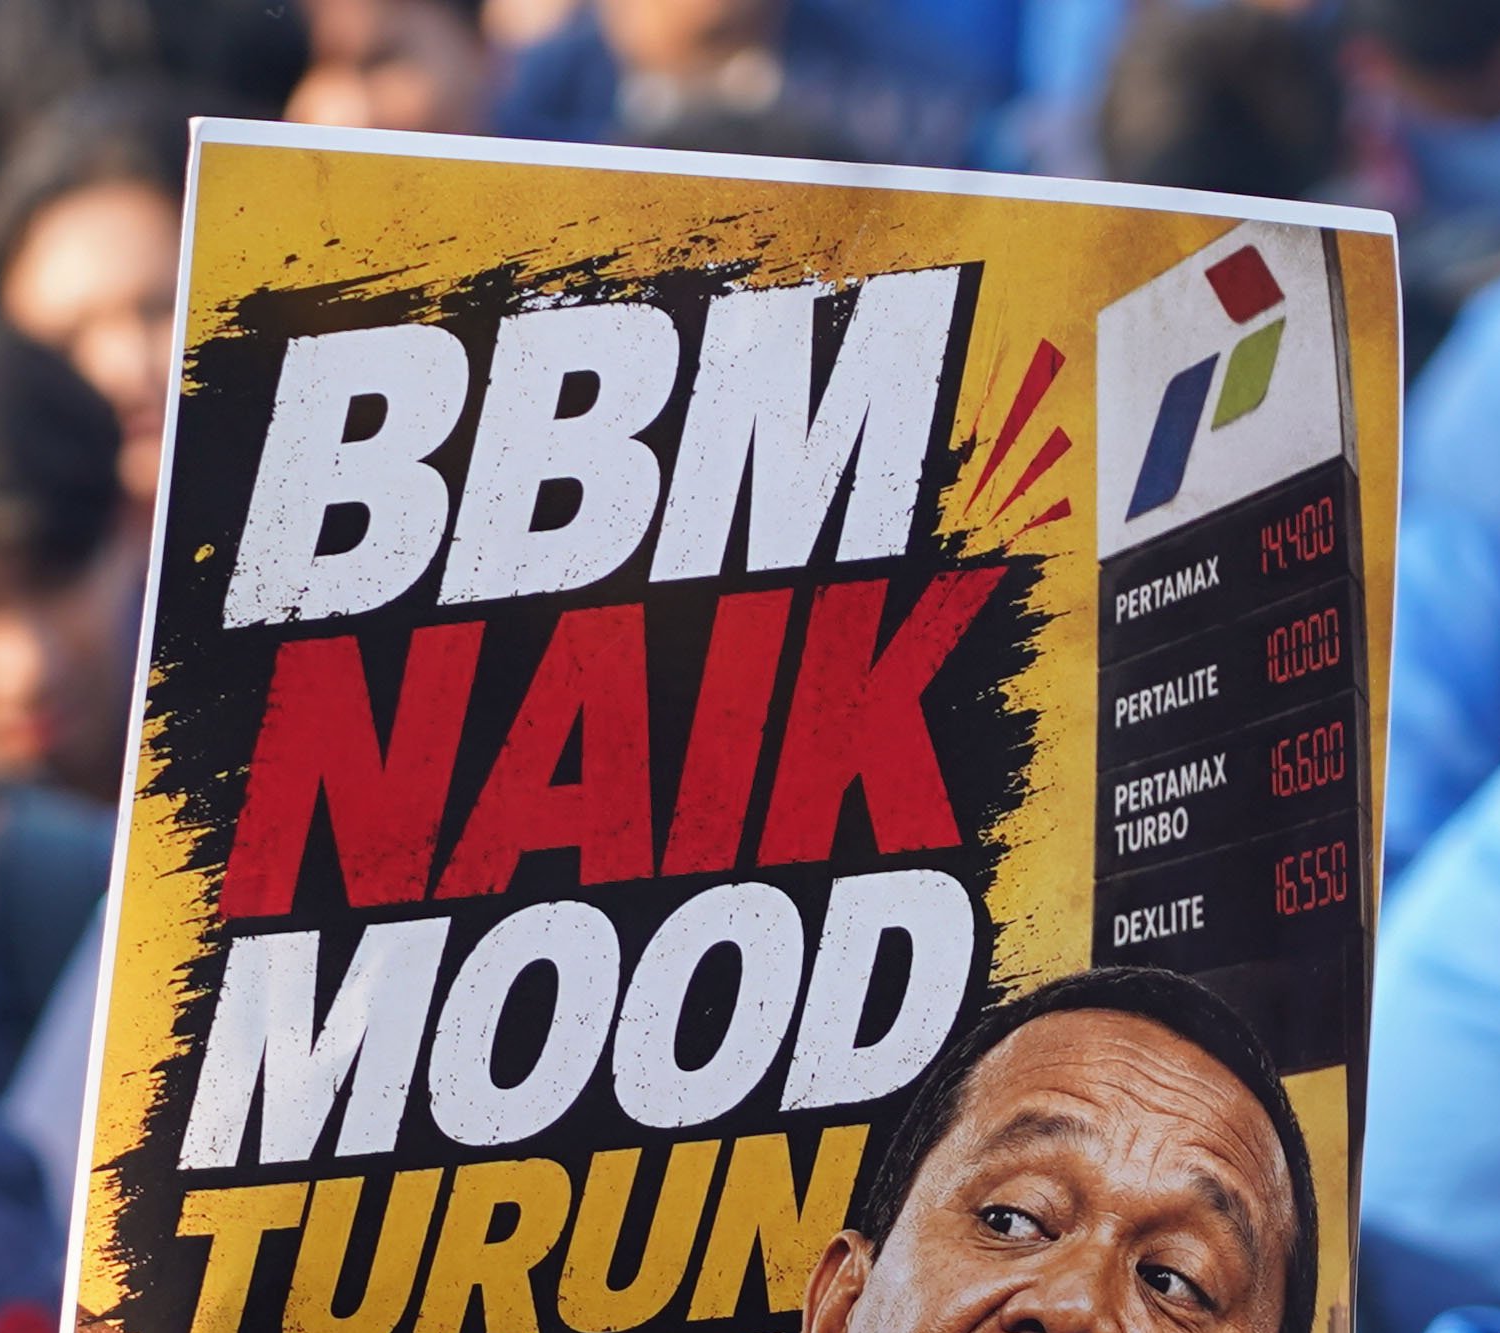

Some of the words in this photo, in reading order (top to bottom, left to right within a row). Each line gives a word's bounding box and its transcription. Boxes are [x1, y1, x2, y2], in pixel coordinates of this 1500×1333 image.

[223, 266, 961, 629] BBM
[1115, 555, 1220, 624] PERTAMAX
[1260, 496, 1335, 574] 14.400
[1115, 664, 1219, 728] PERTALITE
[1266, 607, 1341, 684] 10.000
[219, 566, 1008, 919] NAIK
[1114, 752, 1228, 817] PERTAMAX
[1271, 721, 1345, 797] 16.600
[1114, 806, 1189, 856] TURBO
[1113, 895, 1205, 947] DEXLITE
[1275, 841, 1347, 915] 16.550
[178, 870, 976, 1169] MOOD
